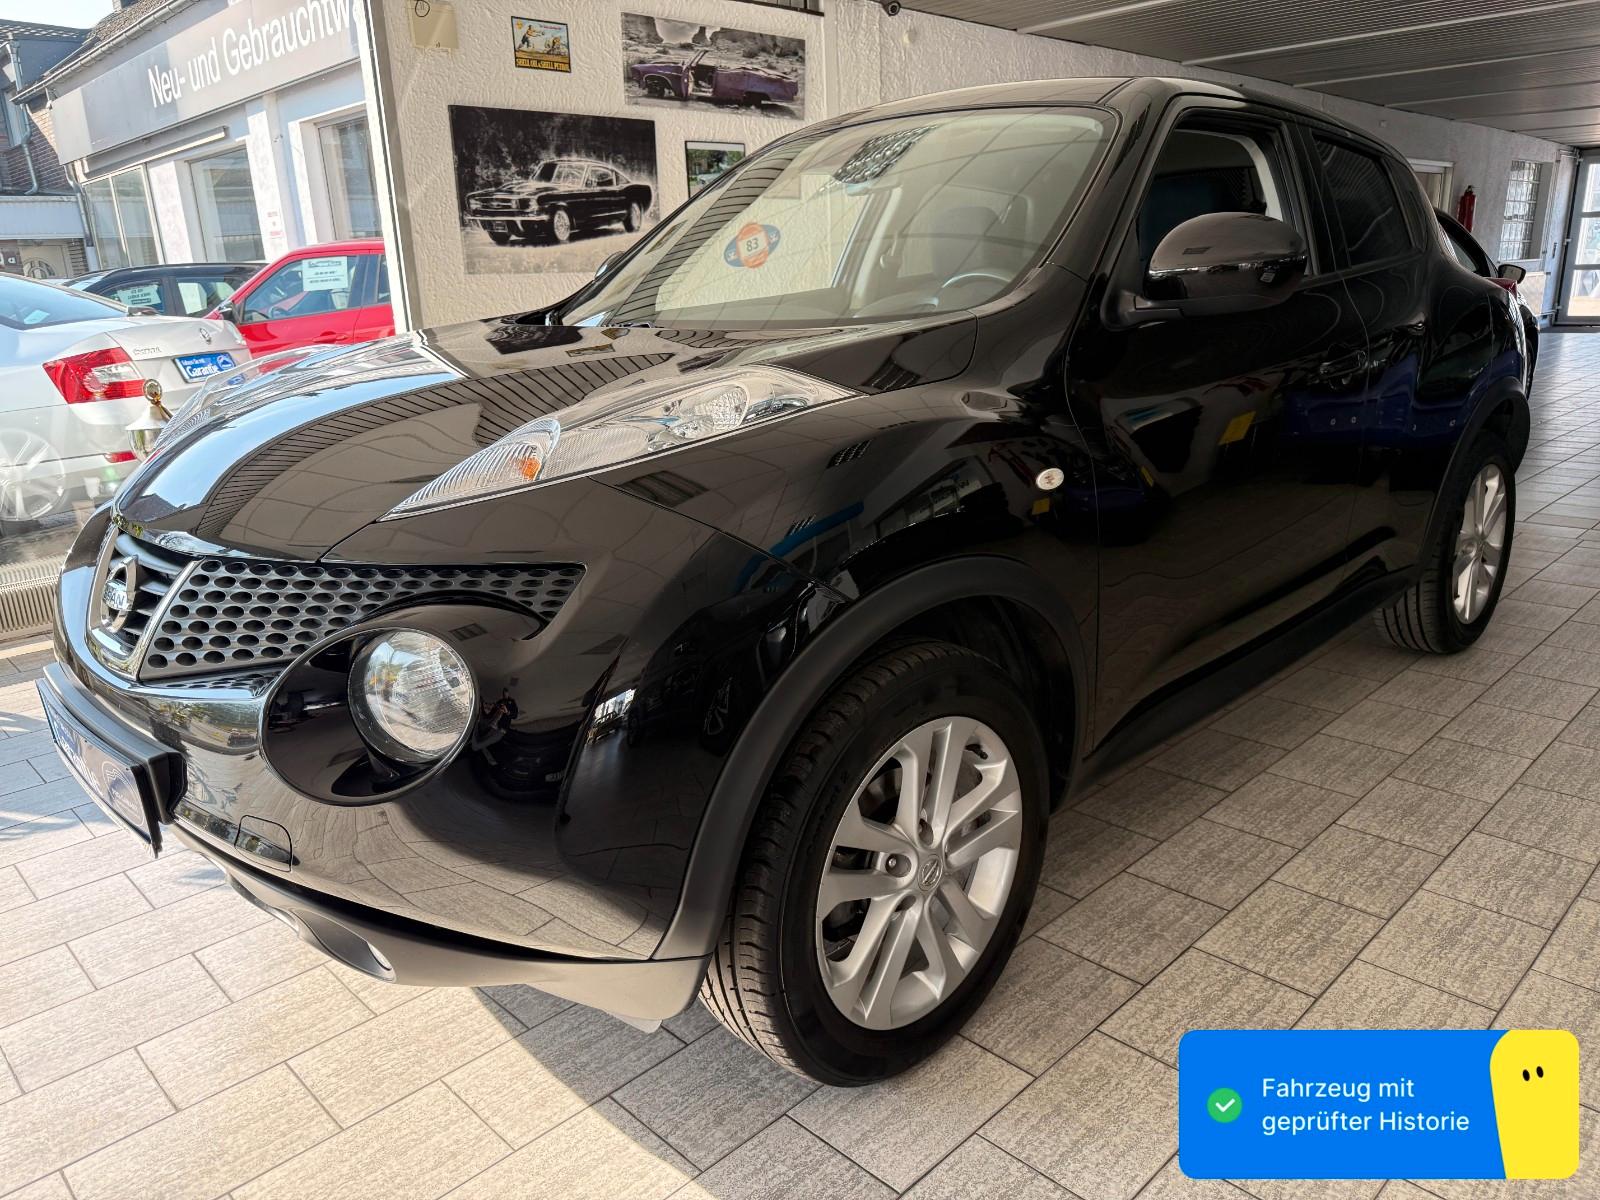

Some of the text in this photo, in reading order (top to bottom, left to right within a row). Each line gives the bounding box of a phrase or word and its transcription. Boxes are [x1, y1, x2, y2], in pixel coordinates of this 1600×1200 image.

[147, 65, 187, 108] Neu-
[187, 37, 222, 92] und
[746, 237, 759, 252] 83
[187, 363, 219, 377] Garantie
